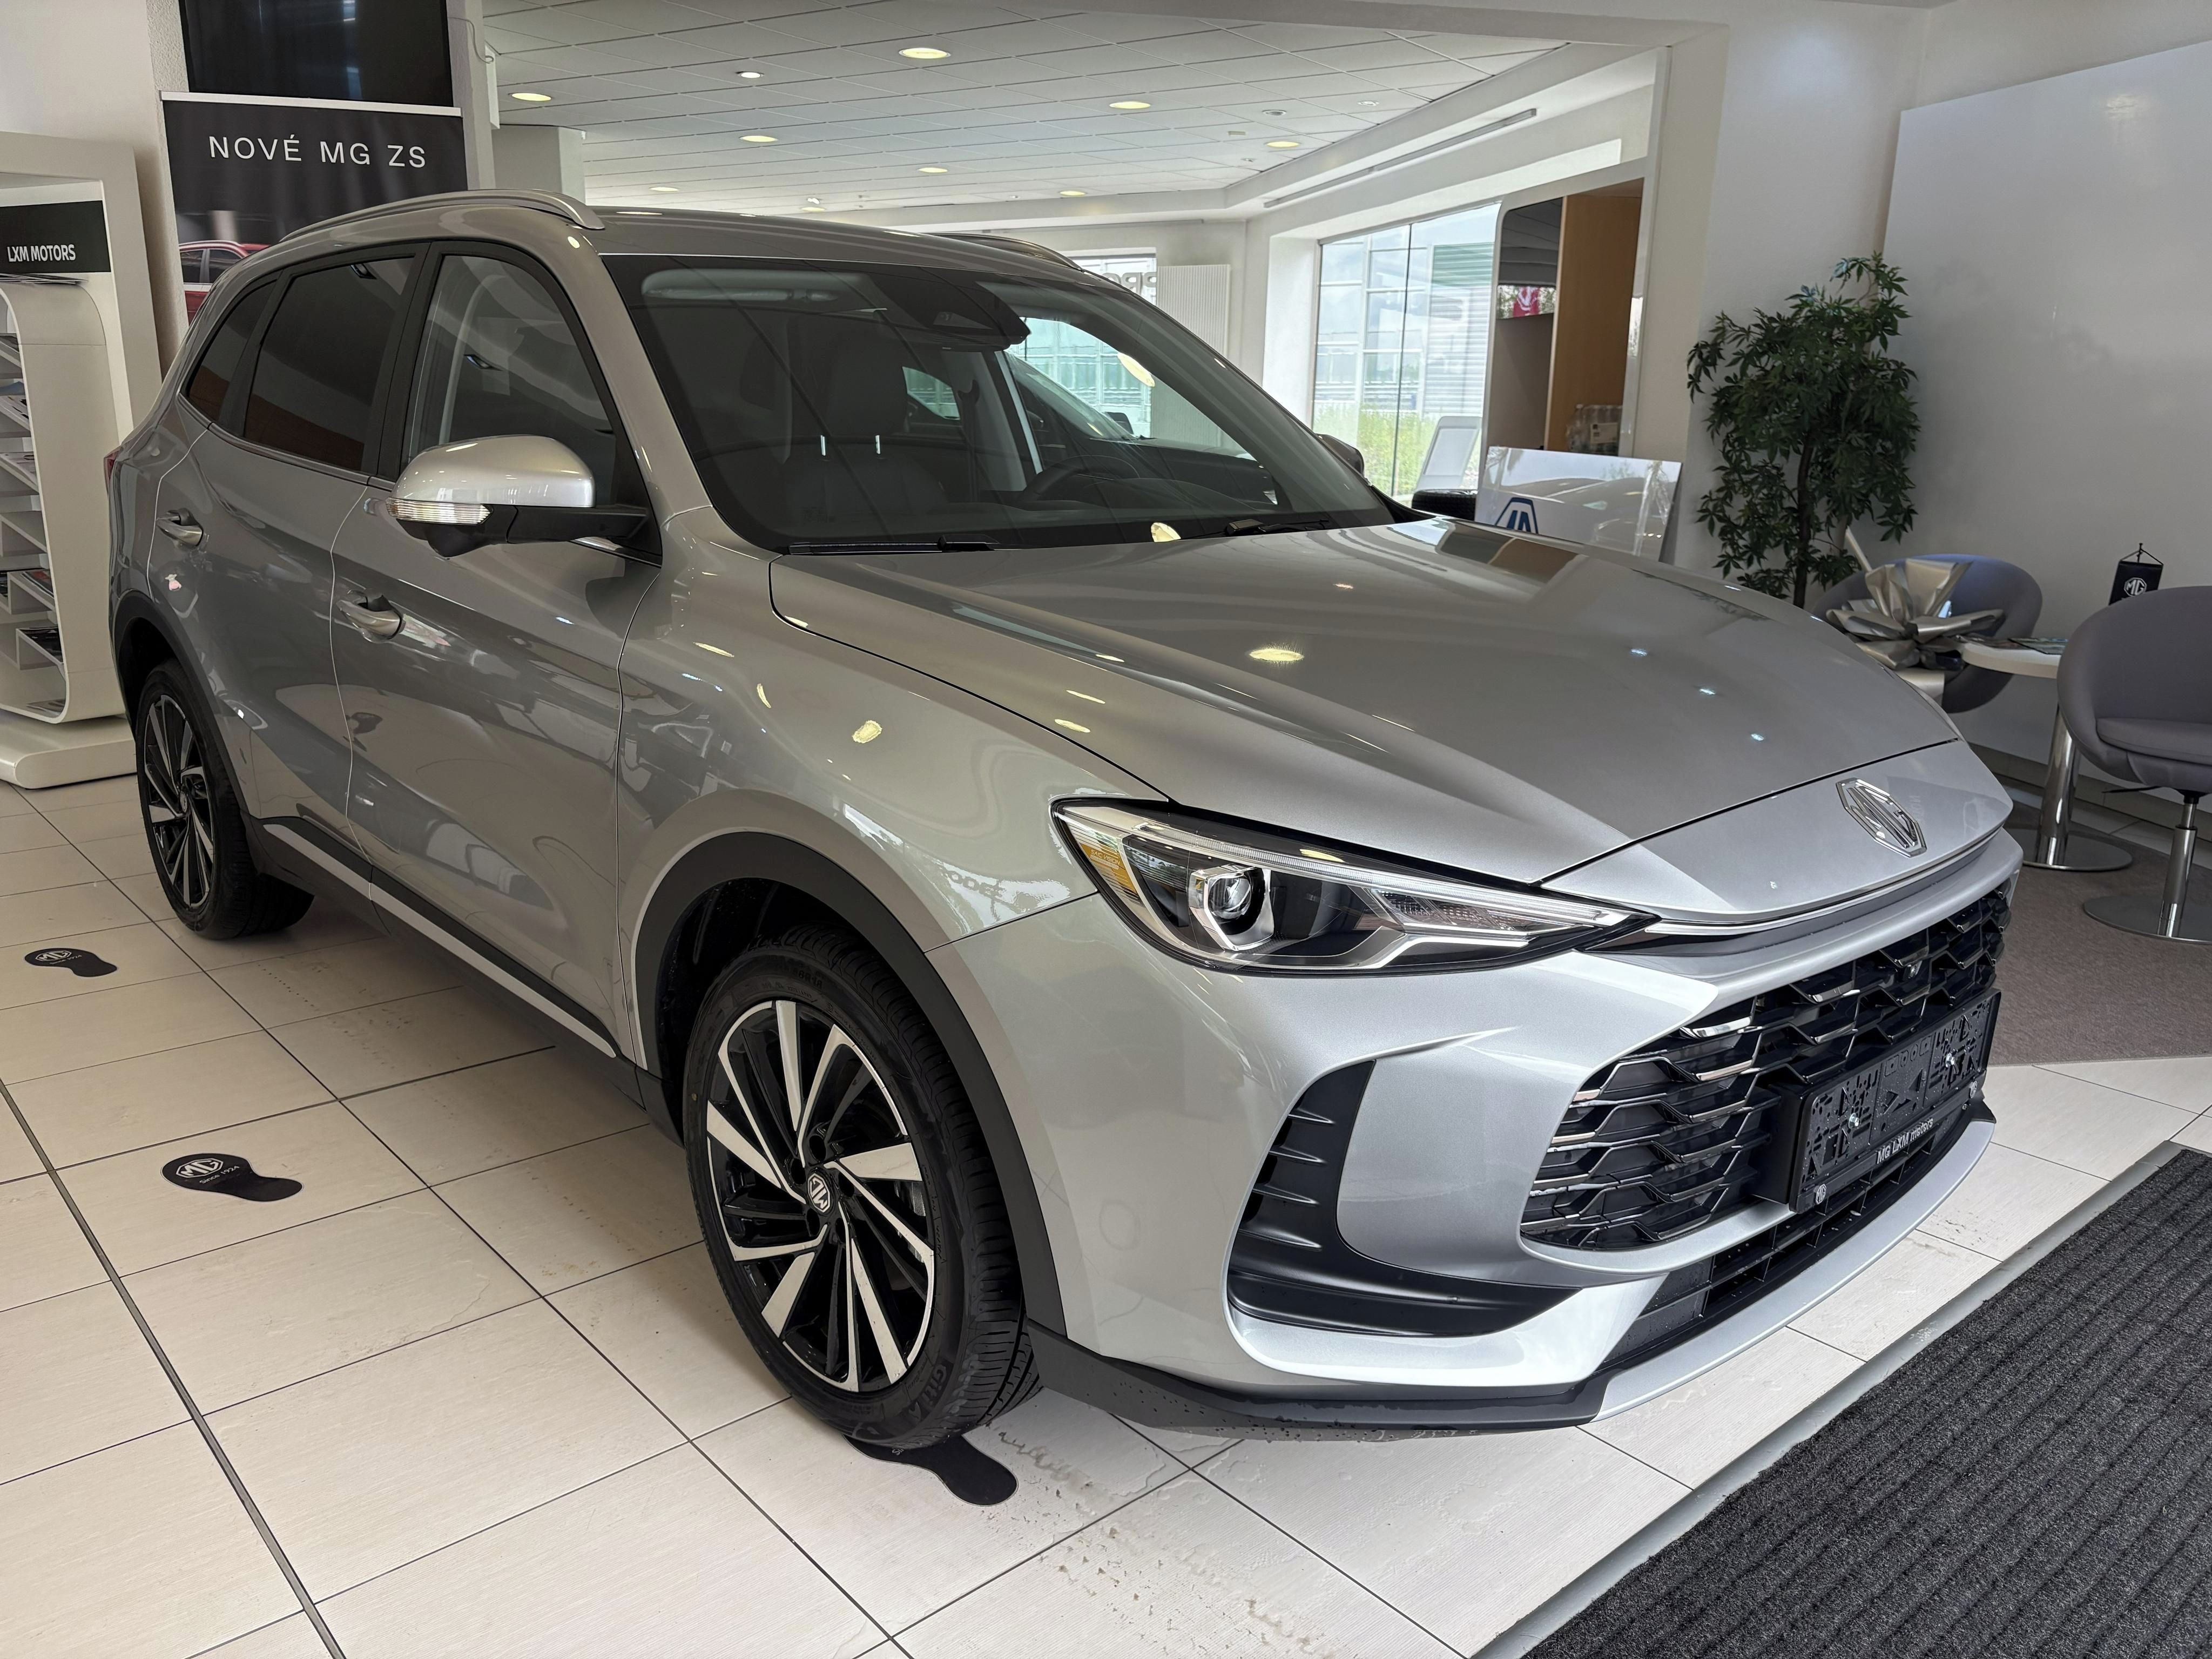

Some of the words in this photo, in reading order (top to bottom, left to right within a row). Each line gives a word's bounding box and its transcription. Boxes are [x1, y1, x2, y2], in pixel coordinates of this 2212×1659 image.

[209, 134, 302, 161] NOVÉ
[320, 141, 370, 165] MG
[387, 144, 426, 168] ZS
[7, 246, 30, 262] LXM
[30, 244, 76, 262] MOTORS
[2126, 579, 2146, 595] MG
[1091, 849, 1103, 858] SAIC
[1103, 854, 1121, 866] VISION
[1877, 1145, 1891, 1164] MG
[1892, 1132, 1910, 1154] LXM
[1910, 1118, 1933, 1142] motors
[180, 1159, 220, 1176] MG
[809, 1176, 828, 1210] MG
